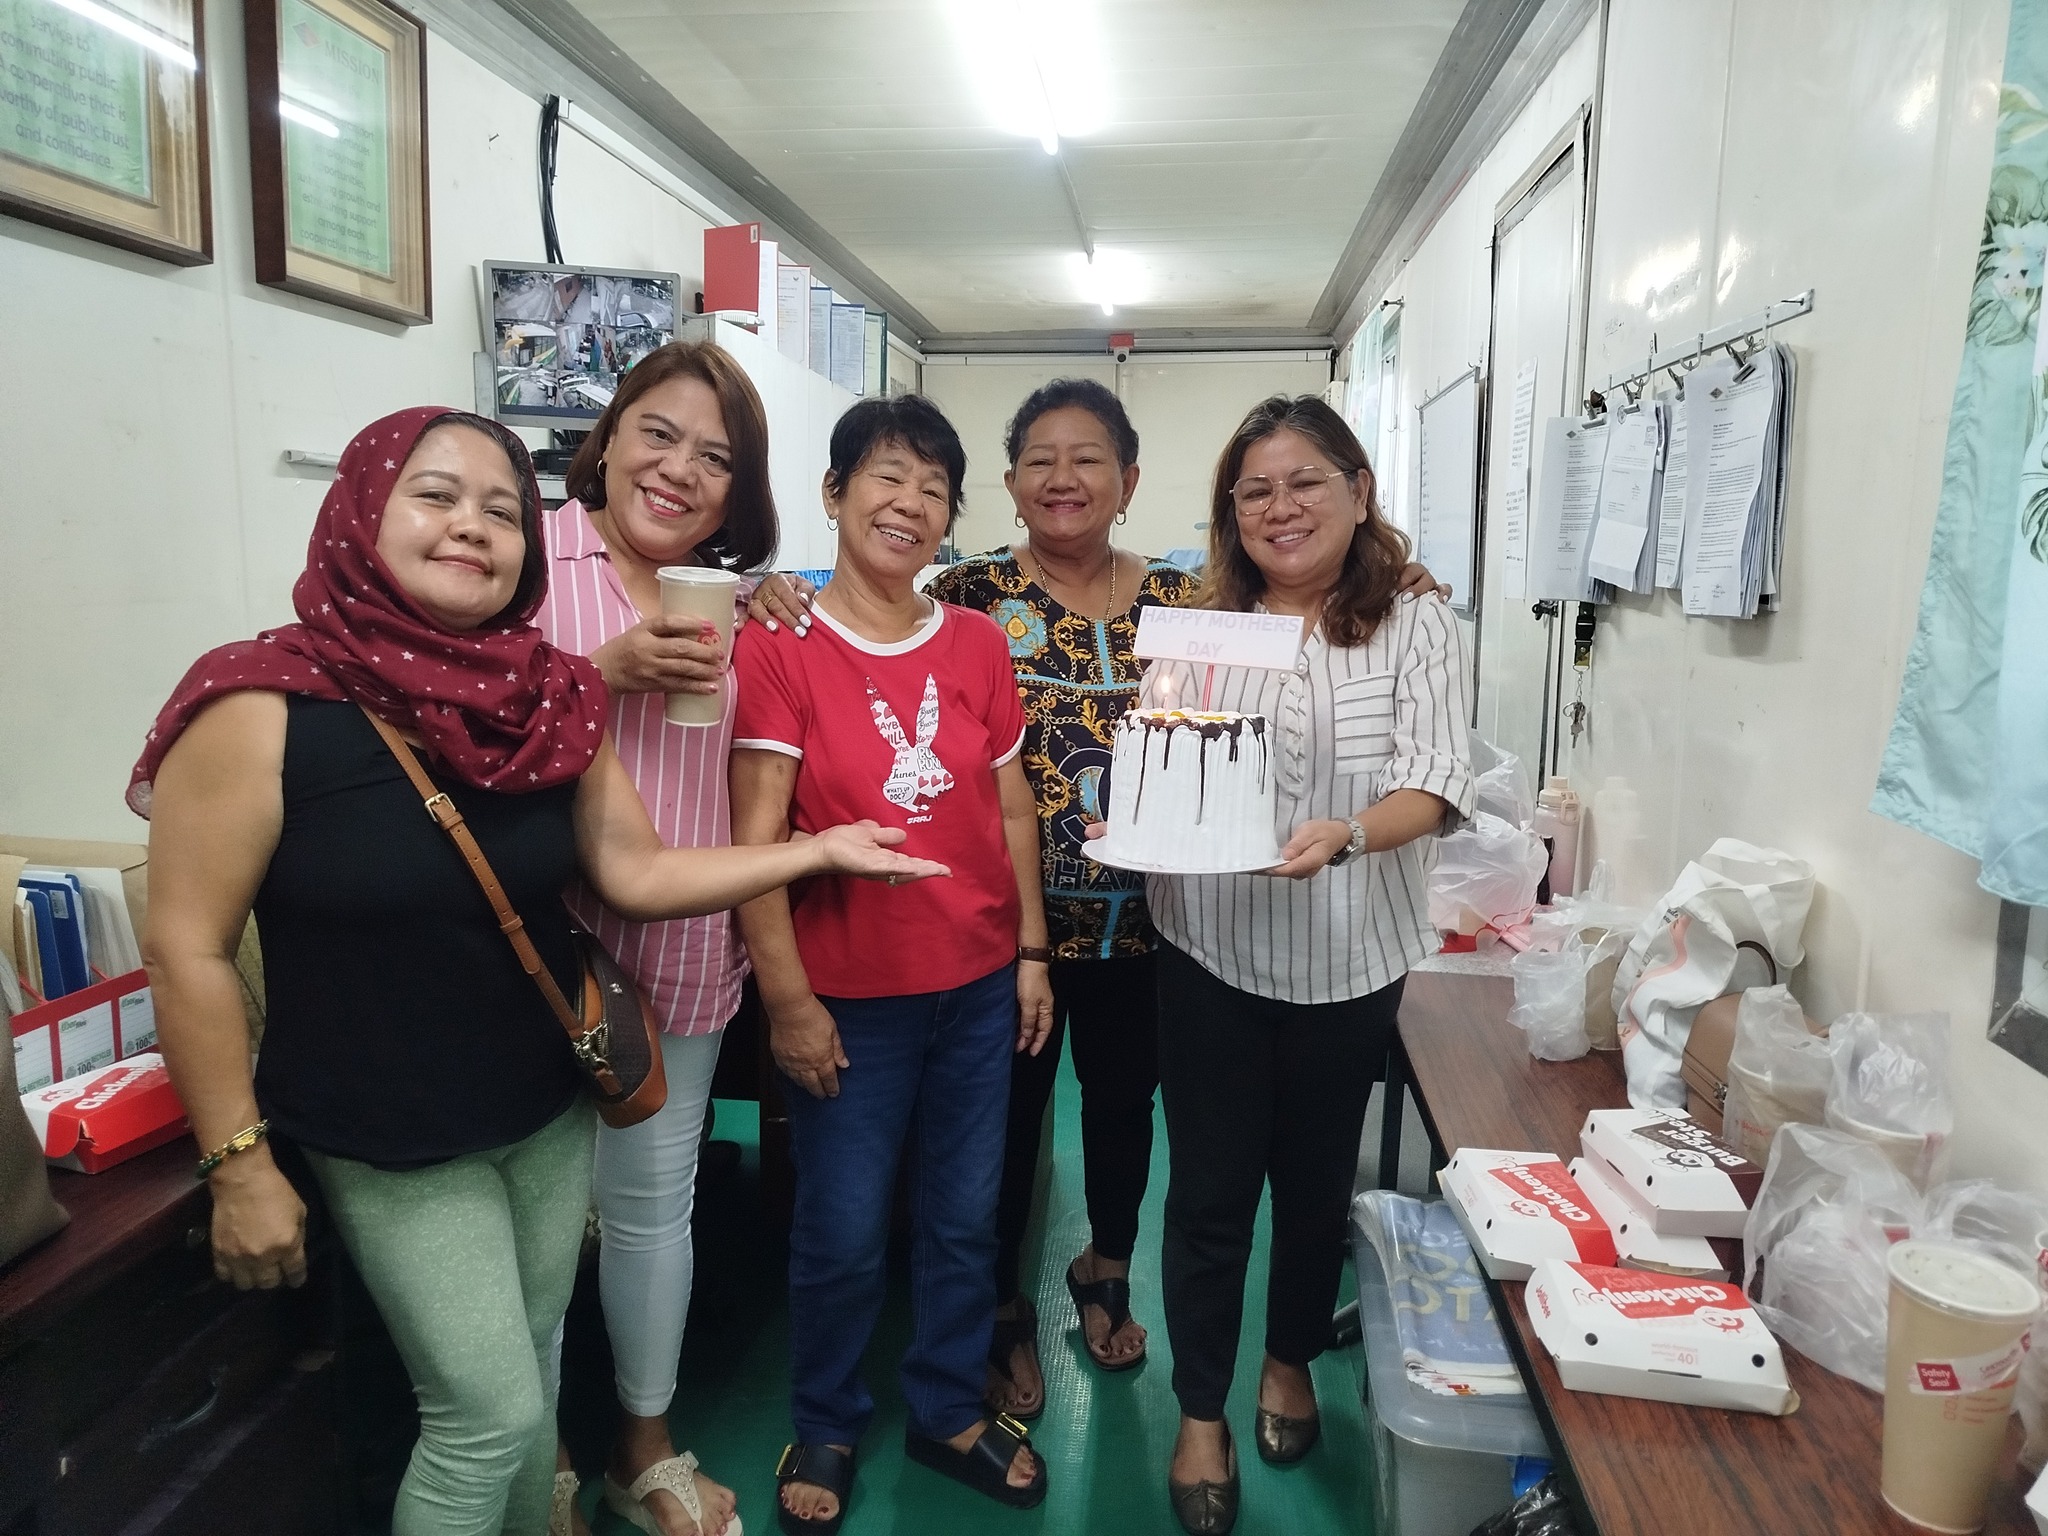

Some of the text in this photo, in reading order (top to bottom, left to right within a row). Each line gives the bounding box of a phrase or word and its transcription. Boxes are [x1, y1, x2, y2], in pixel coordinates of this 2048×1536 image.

[1, 30, 76, 76] commuting
[77, 36, 89, 52] to
[324, 39, 380, 86] MISSION
[9, 63, 86, 106] cooperative
[89, 94, 116, 118] that
[119, 105, 127, 121] is
[45, 104, 58, 121] of
[60, 112, 100, 139] public
[102, 125, 129, 150] trust
[15, 123, 115, 170] and confidence.
[1142, 607, 1300, 634] HAPPY MOTHERS
[1186, 640, 1224, 658] DAY
[1658, 1129, 1748, 1167] Burger
[1572, 1286, 1728, 1310] Chickenjoy
[1677, 1352, 1694, 1365] 40
[1921, 1368, 1951, 1379] Safety
[1928, 1378, 1950, 1387] Seal
